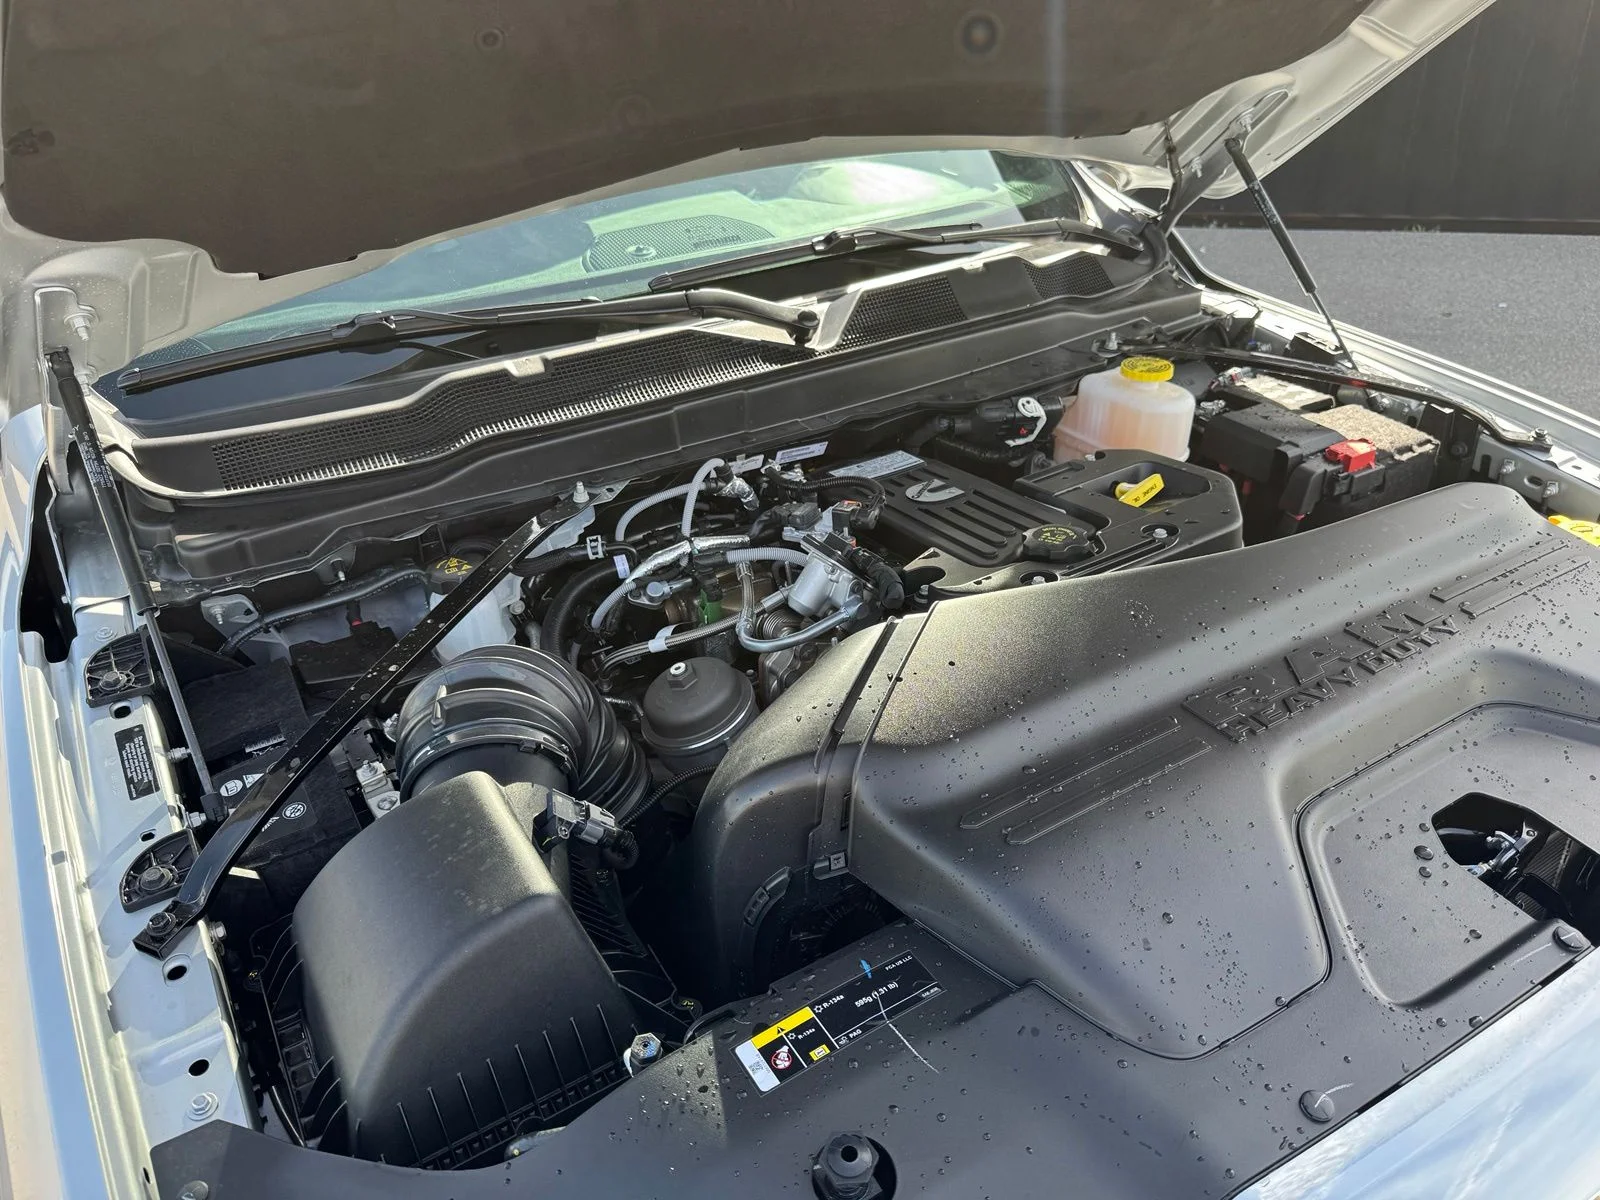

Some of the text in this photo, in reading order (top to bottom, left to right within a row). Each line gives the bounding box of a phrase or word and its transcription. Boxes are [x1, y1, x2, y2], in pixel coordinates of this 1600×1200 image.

[1182, 601, 1444, 728] RAM
[1217, 666, 1360, 742] HEAVY
[902, 954, 913, 962] LLC
[822, 993, 845, 1009] R-134a
[855, 994, 873, 1008] 595g
[887, 980, 899, 991] lb)
[797, 1027, 815, 1039] R-134a
[848, 1028, 862, 1038] PAG
